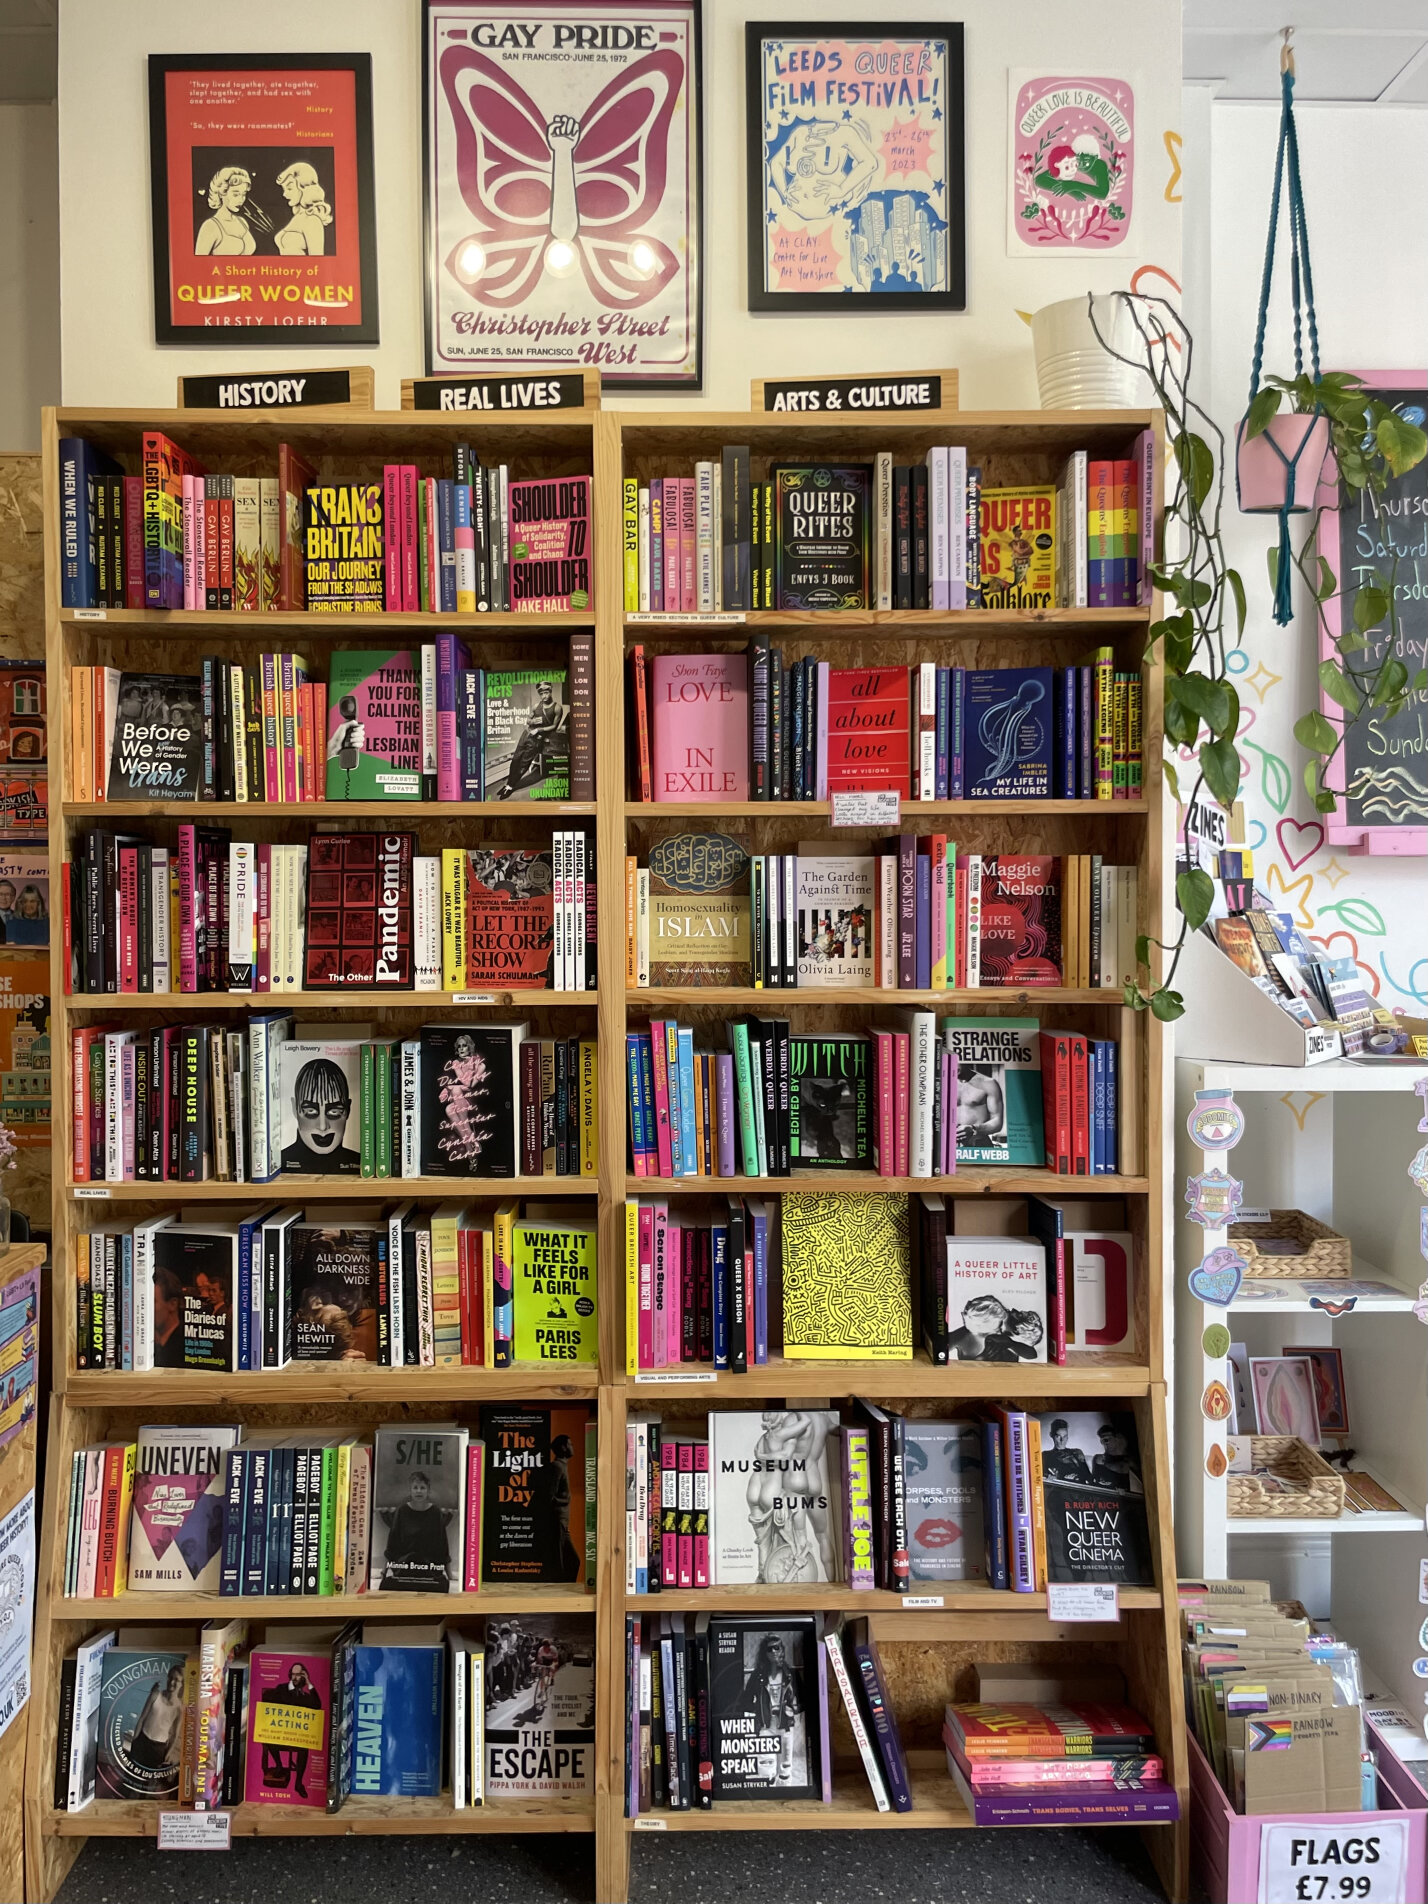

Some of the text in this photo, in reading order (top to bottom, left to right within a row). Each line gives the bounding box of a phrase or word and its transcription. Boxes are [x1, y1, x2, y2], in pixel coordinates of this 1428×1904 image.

[471, 23, 657, 51] GAY PRIDE
[774, 49, 933, 76] LEEDS QUEER
[189, 89, 207, 97] slept
[306, 106, 334, 114] History
[1020, 91, 1129, 139] QUEER LOVE IS BEAUTIFUL
[208, 122, 224, 130] they
[892, 158, 916, 171] 2023
[212, 266, 319, 278] A Short History of
[177, 285, 354, 303] QUEER WOMEN
[450, 311, 670, 342] Christopher Street
[447, 347, 573, 357] SUN, JUNE 25, SAN FRANCISCO
[577, 342, 638, 365] West
[219, 379, 306, 408] HISTORY
[440, 381, 562, 411] REAL LIVES
[773, 383, 930, 412] ARTS & CULTURE
[512, 481, 587, 524] SHOULDER
[789, 492, 855, 514] QUEER
[625, 483, 637, 551] GAY BAR
[792, 516, 854, 538] RITES
[567, 520, 586, 558] TO
[513, 558, 589, 599] SHOULDER
[378, 669, 421, 683] THANK
[487, 671, 566, 686] REVOLUTIONARY
[368, 686, 421, 701] YOU FOR
[487, 685, 513, 698] ACTS
[666, 682, 734, 703] LOVE
[851, 675, 881, 697] all
[367, 703, 420, 718] CALLING
[835, 710, 896, 729] about
[123, 723, 191, 741] Before
[395, 721, 420, 736] THE
[121, 740, 153, 757] We
[365, 738, 419, 752] LESBIAN
[844, 743, 888, 760] love
[119, 758, 172, 775] Were
[391, 755, 419, 770] LINE
[685, 748, 714, 768] IN
[129, 767, 188, 788] trans
[663, 772, 737, 793] EXILE
[996, 777, 1048, 787] MY LIFE IN
[970, 786, 1048, 796] SEA CREATURES
[1191, 801, 1225, 846] ZINES
[802, 871, 868, 883] The Garden
[981, 862, 1041, 879] Maggie
[237, 862, 246, 899] PRIDE
[799, 883, 872, 895] Against Time
[996, 881, 1056, 896] Nelson
[376, 836, 400, 983] Pandemic
[656, 902, 742, 915] Homosexuality
[471, 915, 549, 932] LET THE
[657, 917, 740, 937] ISLAM
[471, 933, 552, 950] RECORD
[471, 952, 526, 968] SHOW
[951, 1031, 1020, 1047] STRANGE
[791, 1042, 866, 1077] WITCH
[953, 1046, 1032, 1062] RELATIONS
[186, 1038, 198, 1124] DEEP HOUSE
[523, 1232, 588, 1249] WHAT IT
[533, 1248, 579, 1264] FEELS
[524, 1264, 589, 1280] LIKE FOR
[954, 1260, 1038, 1270] A QUEER LITTLE
[955, 1270, 1038, 1280] HISTORY OF ART
[533, 1280, 581, 1296] A GIRL
[498, 1431, 536, 1449] The
[141, 1445, 221, 1475] UNEVEN
[492, 1450, 544, 1472] Light
[721, 1459, 806, 1473] MUSEUM
[509, 1470, 531, 1487] of
[498, 1485, 535, 1508] Day
[773, 1496, 828, 1509] BUMS
[1064, 1511, 1120, 1530] NEW
[1067, 1532, 1123, 1547] QUEER
[1068, 1548, 1125, 1561] CINEMA
[134, 1569, 182, 1580] SAM MILLS
[1209, 1584, 1245, 1594] RAINBOW
[265, 1707, 317, 1721] STRAIGHT
[270, 1719, 309, 1731] ACTING
[720, 1718, 755, 1734] WHEN
[1293, 1718, 1335, 1731] RAINBOW
[355, 1685, 383, 1791] HEAVEN
[522, 1730, 552, 1748] THE
[720, 1738, 780, 1754] MONSTERS
[490, 1748, 585, 1779] ESCAPE
[720, 1758, 756, 1774] SPEAK
[1290, 1837, 1380, 1866] FLAGS
[1295, 1876, 1371, 1900] £7.99
